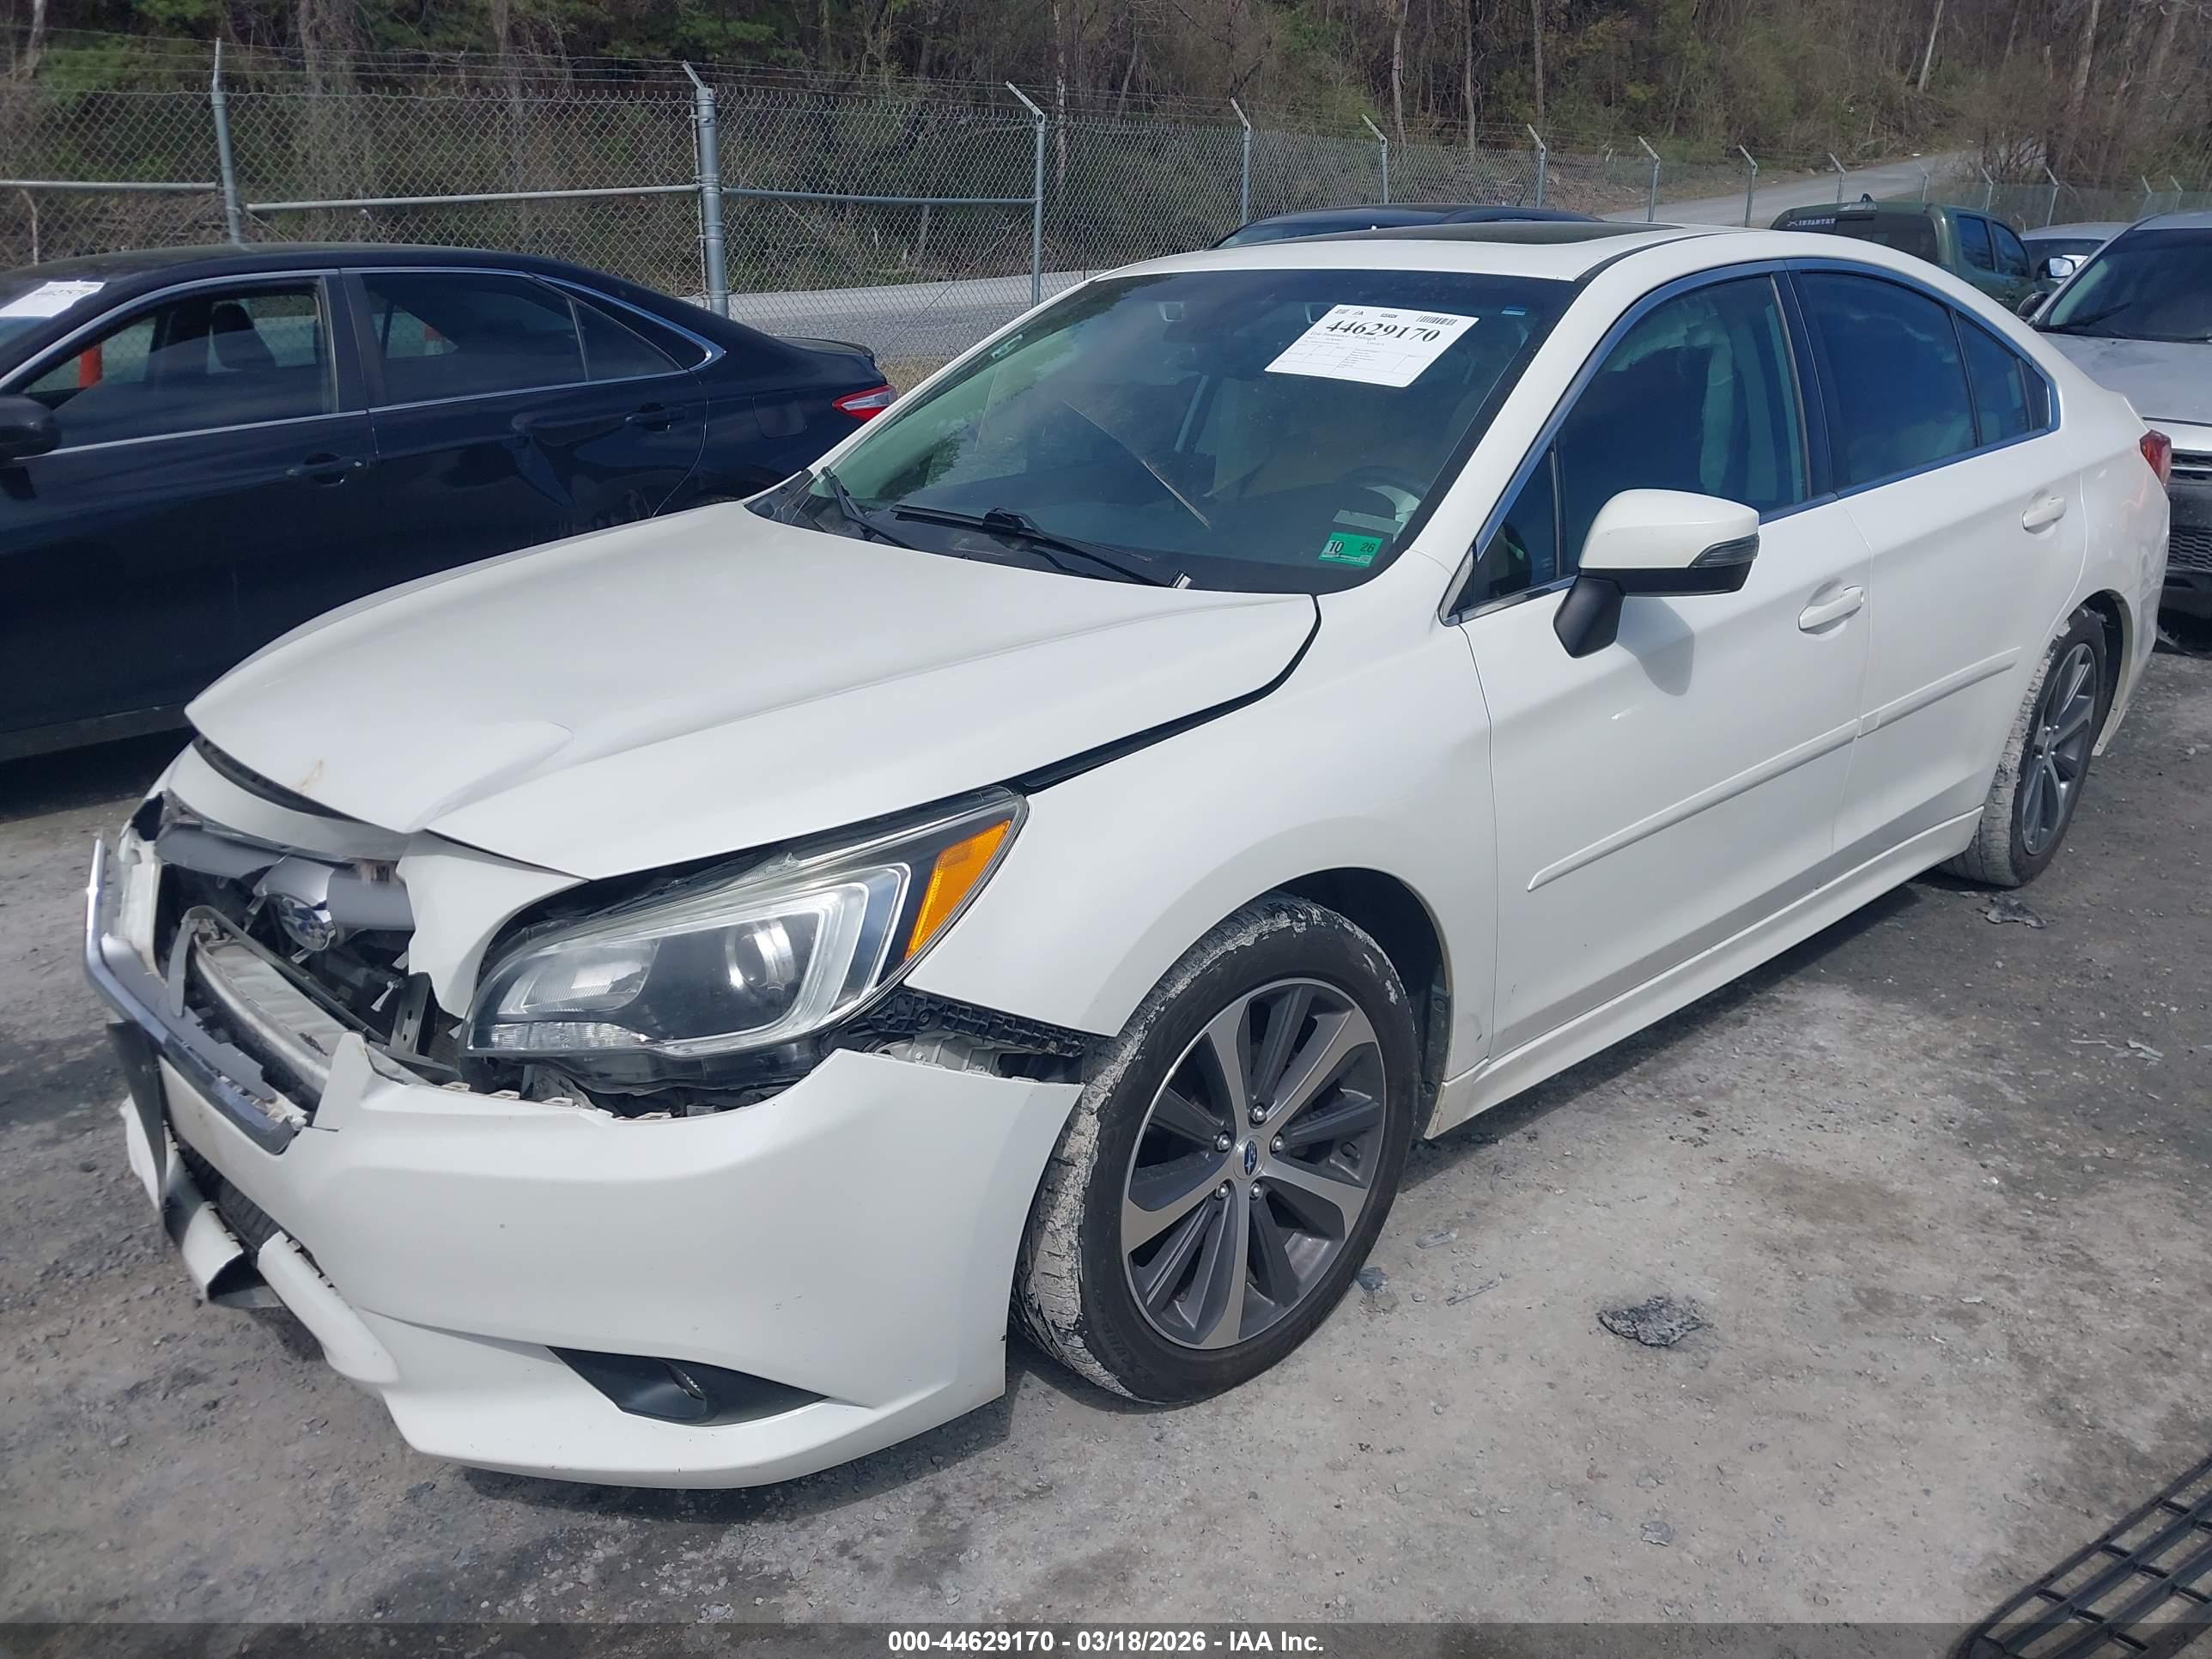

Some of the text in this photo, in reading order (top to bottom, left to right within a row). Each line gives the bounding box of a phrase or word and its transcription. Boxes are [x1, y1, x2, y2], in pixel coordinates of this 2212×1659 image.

[1326, 319, 1441, 343] 44629170
[1329, 541, 1376, 553] 10 26
